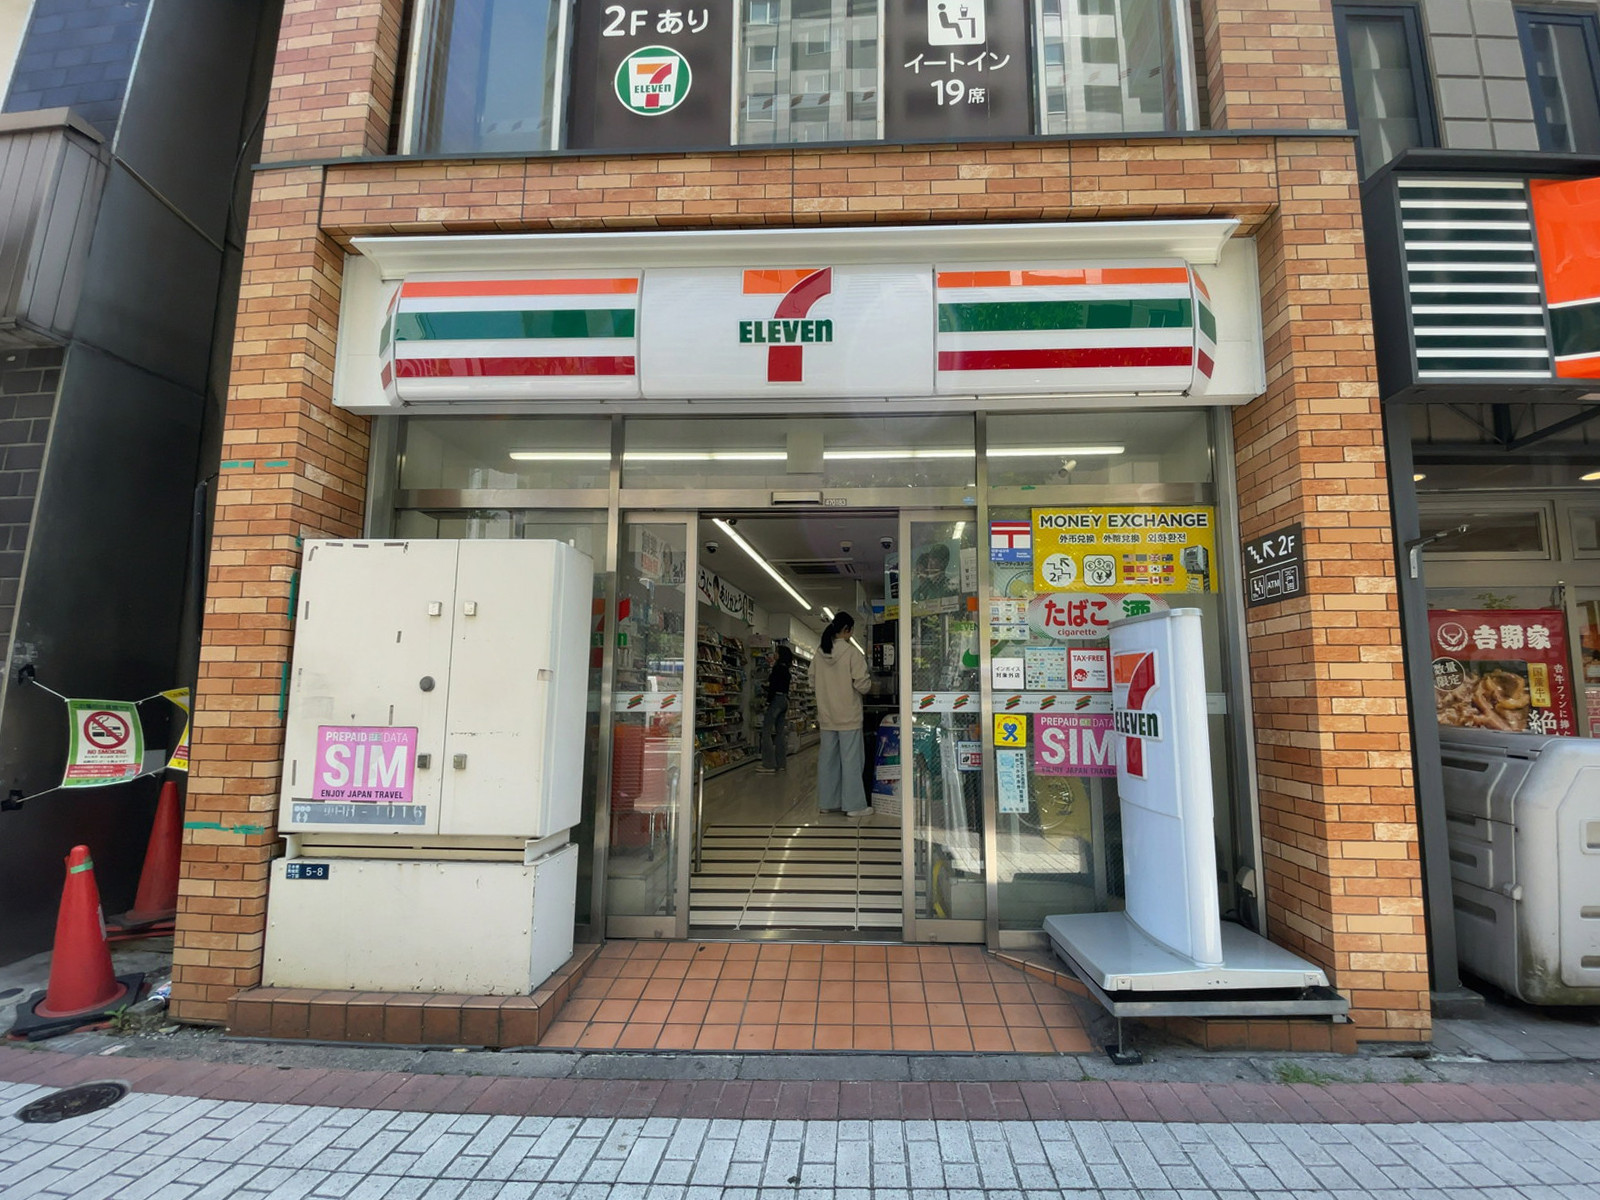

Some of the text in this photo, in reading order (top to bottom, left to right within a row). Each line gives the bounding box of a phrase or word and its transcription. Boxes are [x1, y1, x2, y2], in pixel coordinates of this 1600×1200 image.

[602, 5, 709, 37] 2F あり
[904, 51, 1010, 74] イートイン
[930, 79, 986, 106] 19席
[1040, 513, 1208, 528] MONEY EXCHANGE
[1277, 535, 1295, 556] 2F
[1049, 572, 1063, 582] 2F
[1267, 579, 1281, 589] ATM
[1044, 599, 1110, 627] たばこ
[1472, 624, 1551, 650] 吉野家
[1072, 654, 1105, 662] TAX-FREE
[1436, 674, 1462, 688] 限定
[1040, 717, 1079, 727] PREPAID
[1092, 718, 1115, 728] DATA
[325, 731, 367, 742] PREPAID
[383, 732, 409, 743] DATA
[1041, 727, 1117, 767] SIM
[322, 744, 408, 788] SIM
[1041, 766, 1064, 774] ENJOY
[320, 789, 404, 799] ENJOY JAPAN TRAVEL
[305, 867, 324, 877] 5-8
